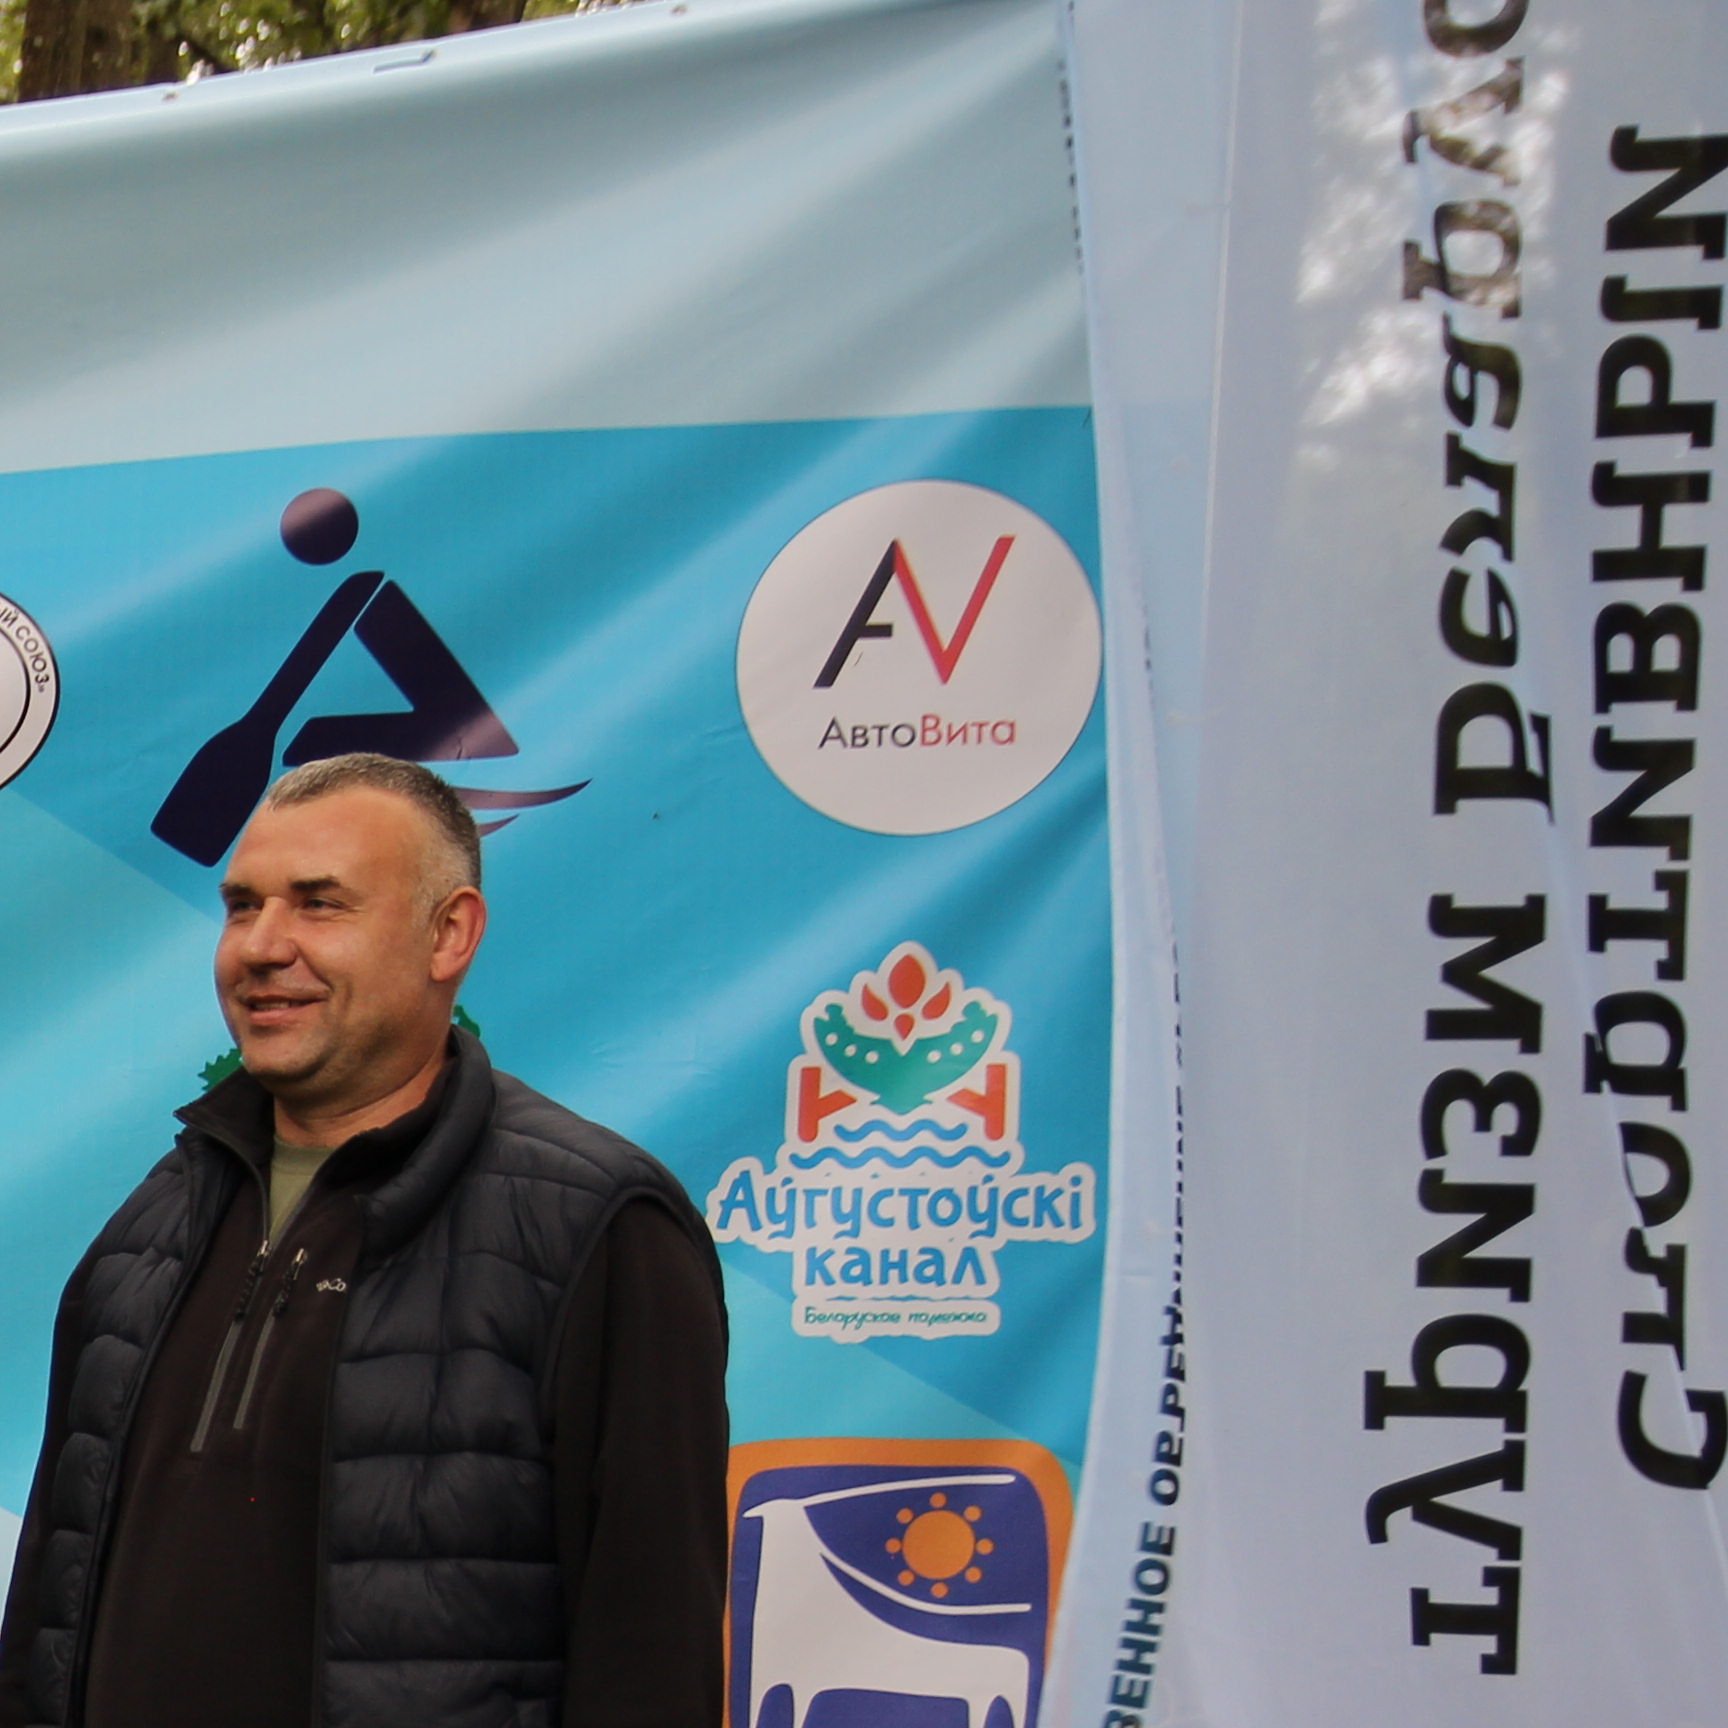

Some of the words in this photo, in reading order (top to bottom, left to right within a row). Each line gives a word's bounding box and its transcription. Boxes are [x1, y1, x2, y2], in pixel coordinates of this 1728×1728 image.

[13, 624, 55, 693] СОЮЗ»
[816, 713, 1017, 750] АвтоВита
[715, 1167, 1084, 1243] Аўгустоўскі
[804, 1245, 986, 1288] канал
